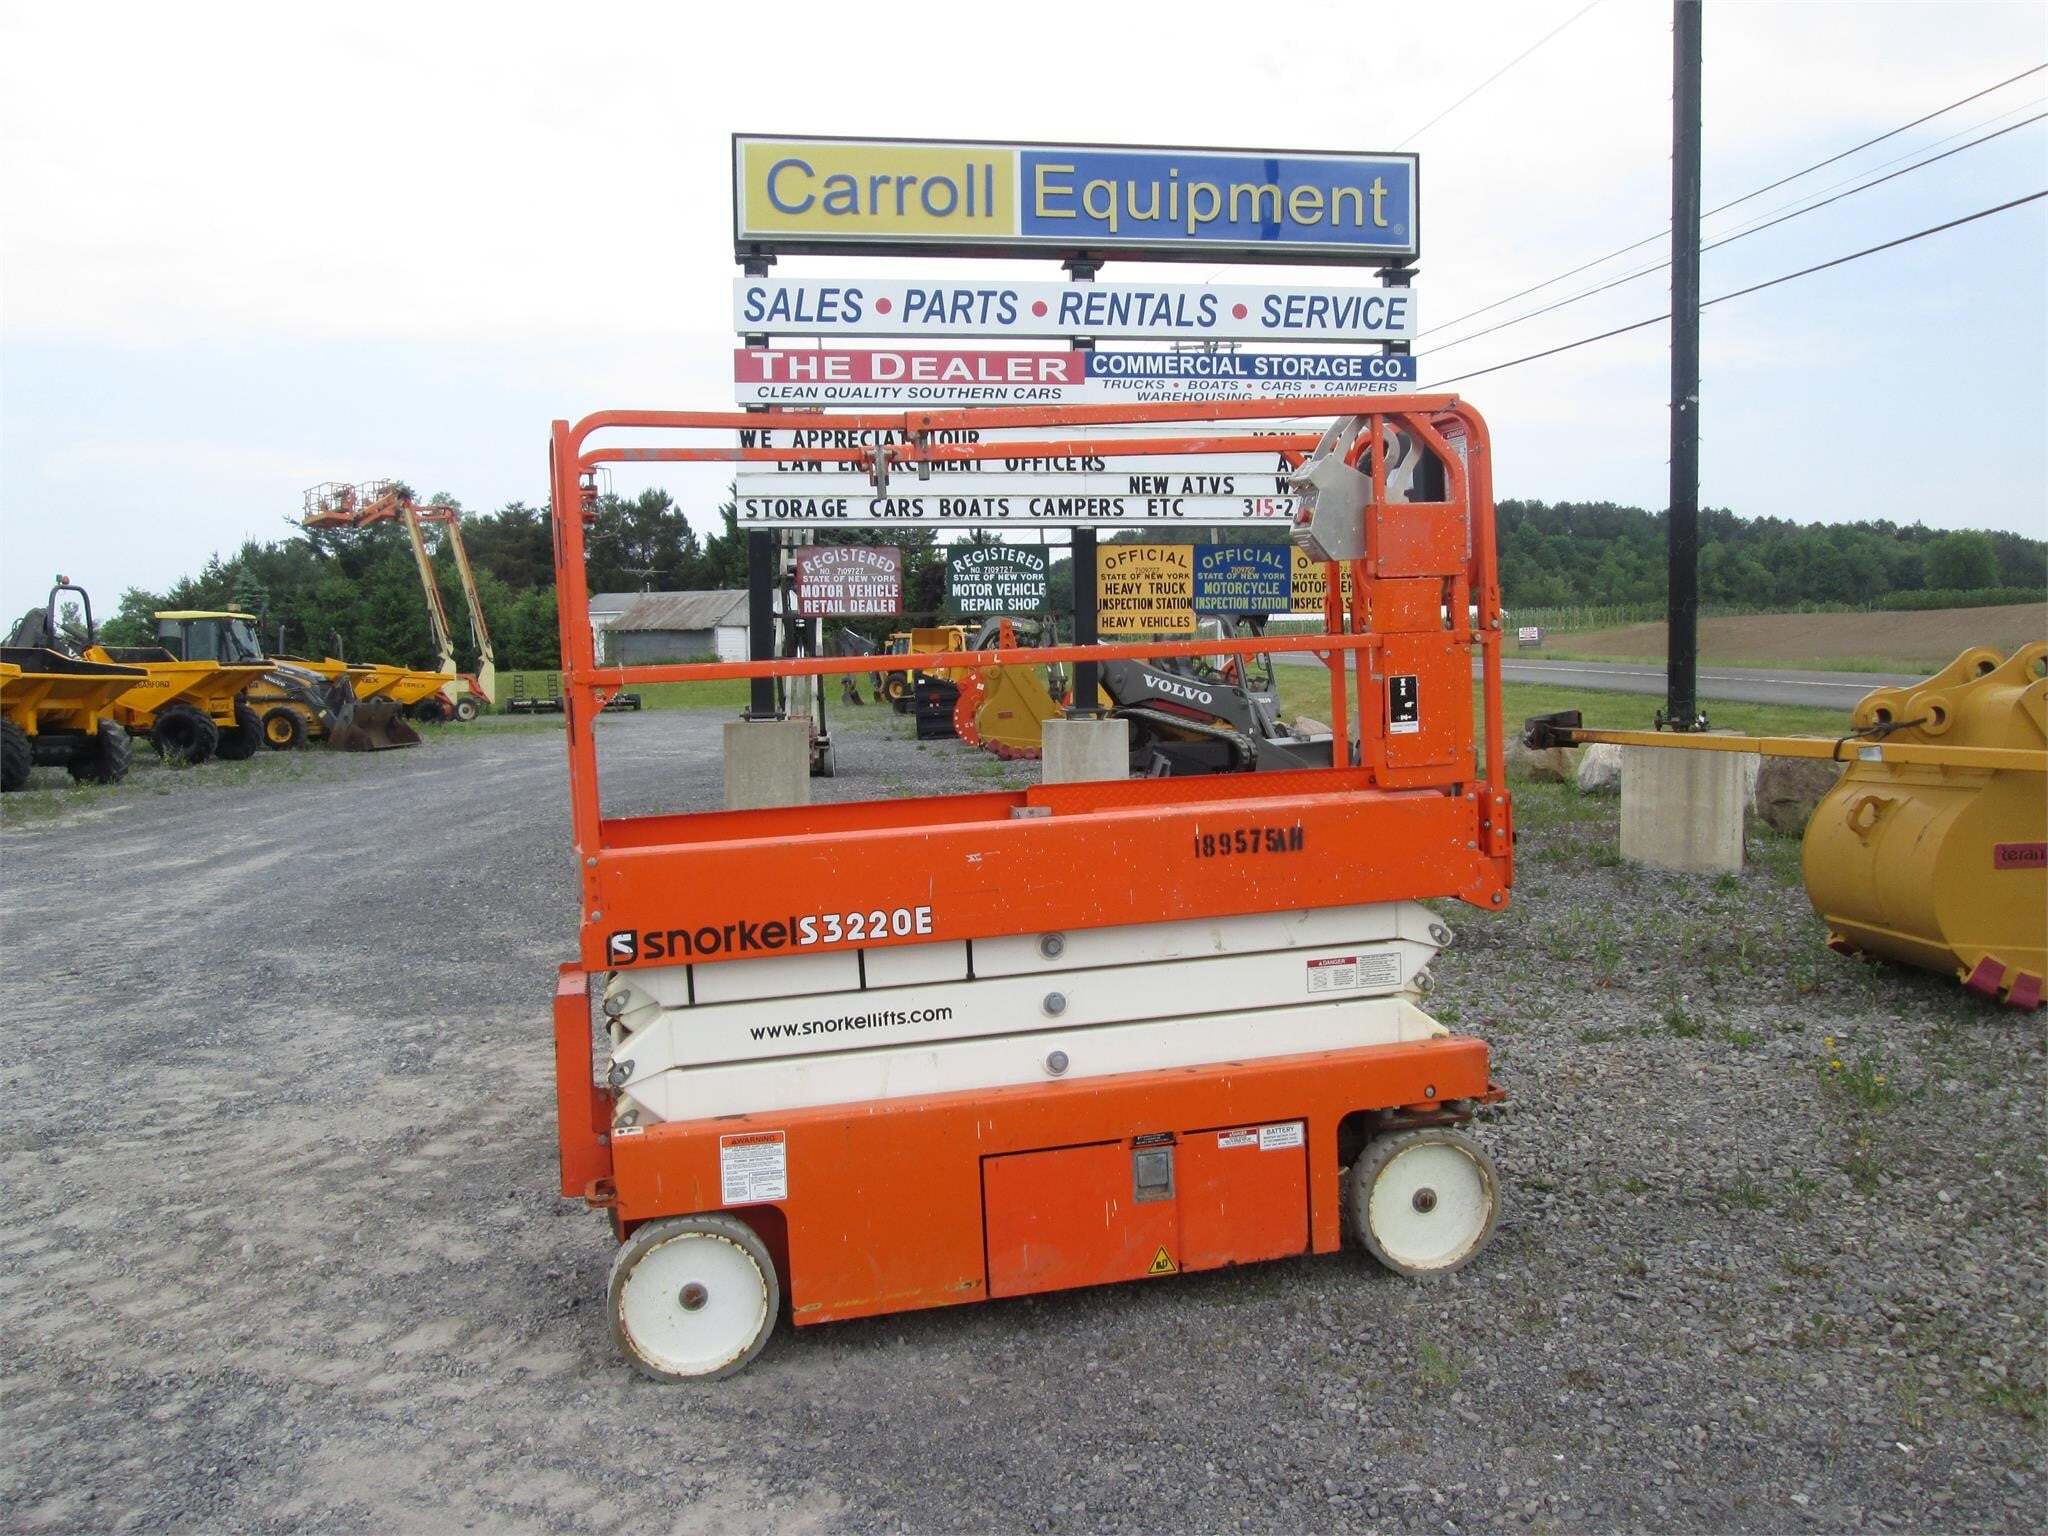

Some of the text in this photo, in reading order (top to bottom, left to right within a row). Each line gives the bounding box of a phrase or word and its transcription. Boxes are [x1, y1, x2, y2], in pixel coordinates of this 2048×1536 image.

[766, 158, 1389, 237] Carroll Equipment
[744, 287, 1408, 331] SALES PARTS RENTALS SERVICE
[751, 352, 1069, 382] THE DEALER
[1093, 355, 1407, 378] COMMERCIAL STORAGE CO.
[757, 386, 1062, 400] CLEAN QUALITY SOUTHERN CARS
[1102, 379, 1398, 393] TRUCKS BOATS CARS CAMPERS
[1137, 392, 1253, 401] WAREHOUSING
[739, 430, 772, 449] WE
[792, 430, 909, 449] APPRECIAT
[1005, 457, 1106, 472] OFFICERS
[1129, 476, 1235, 495] NEW ATVS
[745, 498, 1294, 518] STORAGE CARS BOATS CAMPERS ETC 315-2
[802, 548, 895, 574] REGISTERED
[952, 547, 1044, 573] REGISTERED
[1105, 548, 1188, 569] OFFICIAL
[1202, 548, 1283, 569] OFFICIAL
[802, 575, 830, 583] STATE
[1020, 573, 1045, 581] YORK
[1167, 572, 1190, 580] YORK
[1263, 572, 1286, 580] YORK
[801, 584, 899, 598] MOTOR VEHICLE
[952, 582, 1046, 597] MOTOR VEHICLE
[1105, 582, 1186, 595] HEAVY TRUCK
[1204, 582, 1280, 595] MOTORCYCLE
[804, 600, 896, 613] RETAIL DEALER
[961, 598, 1040, 611] REPAIR SHOP
[1099, 597, 1192, 610] INSPECTION STATION
[1195, 597, 1288, 610] INSPECTION STATION
[1291, 597, 1323, 610] INSPEC
[1102, 616, 1190, 628] HEAVY VEHICLES
[1143, 674, 1213, 705] VOLVO
[643, 917, 798, 960] snorkel
[799, 905, 934, 945] S3220E
[750, 1004, 953, 1041] www.snorkellifts.com
[1266, 1126, 1295, 1135] BATTERY
